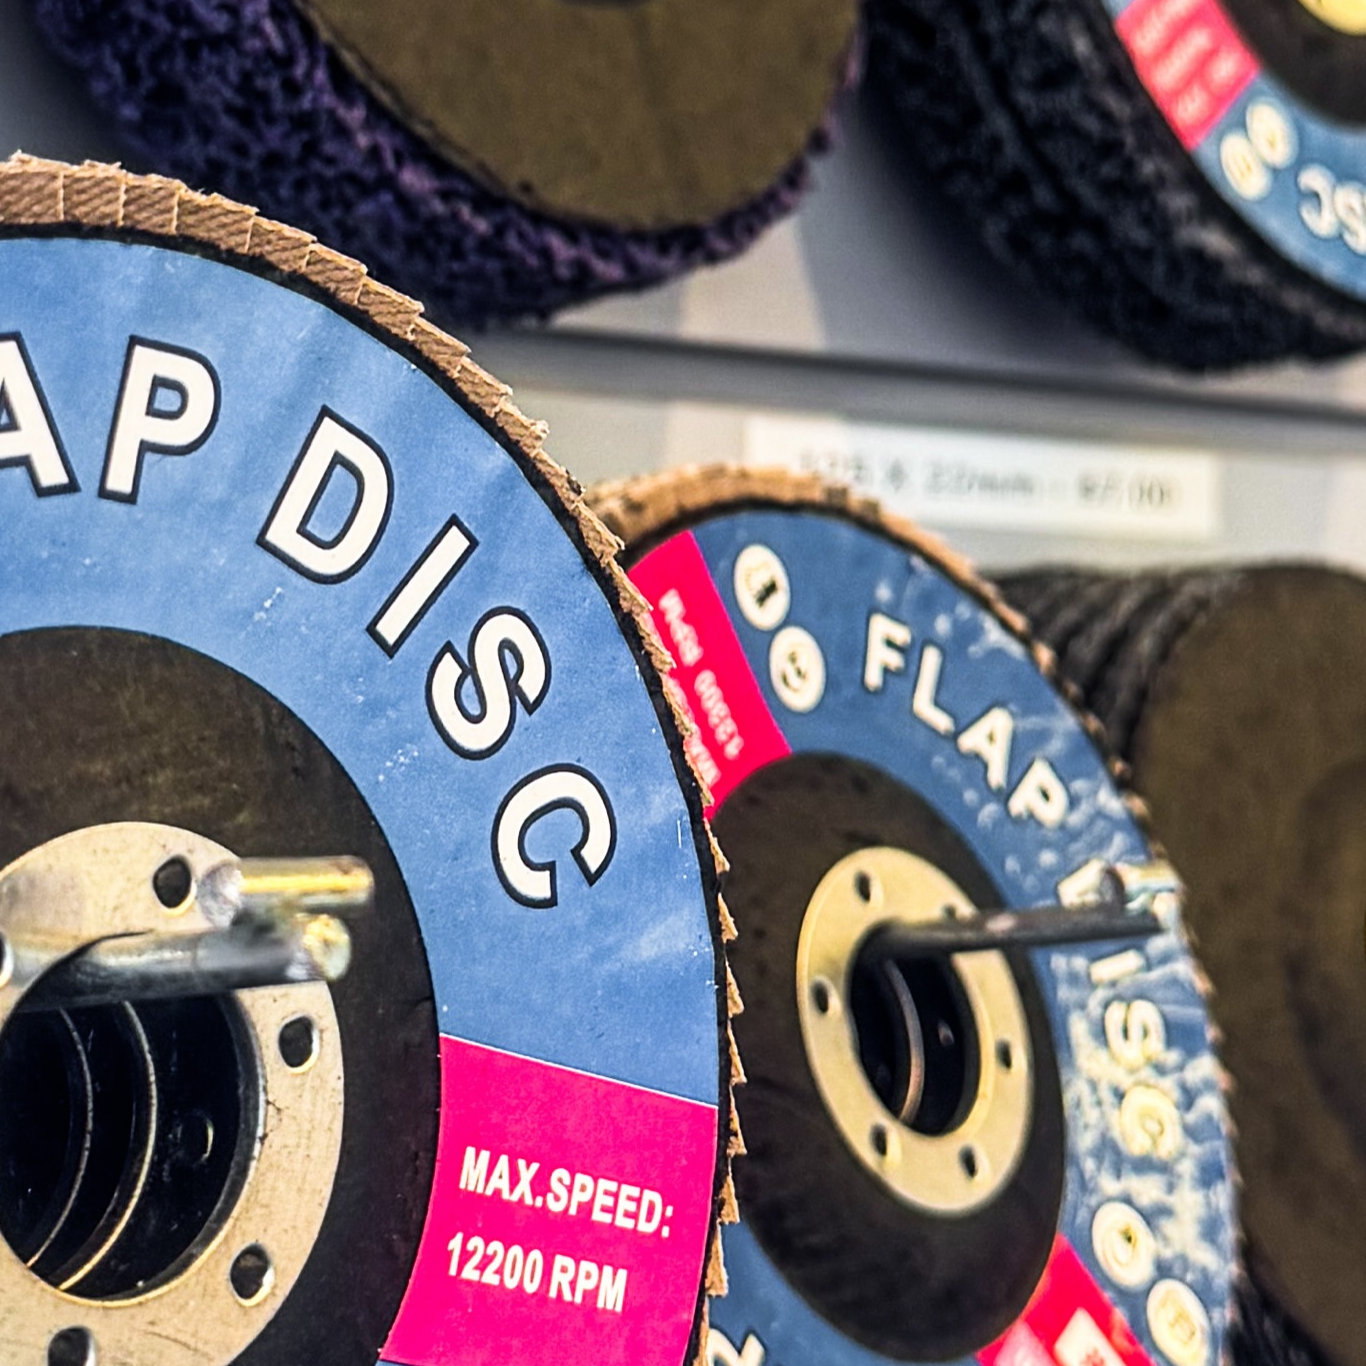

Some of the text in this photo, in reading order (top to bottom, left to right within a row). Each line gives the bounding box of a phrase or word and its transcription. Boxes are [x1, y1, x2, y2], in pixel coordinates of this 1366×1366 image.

[257, 403, 618, 908] DISC
[862, 612, 1071, 828] FLAP
[458, 1145, 675, 1241] MAX.SPEED:
[446, 1232, 628, 1315] 12200 RPM
